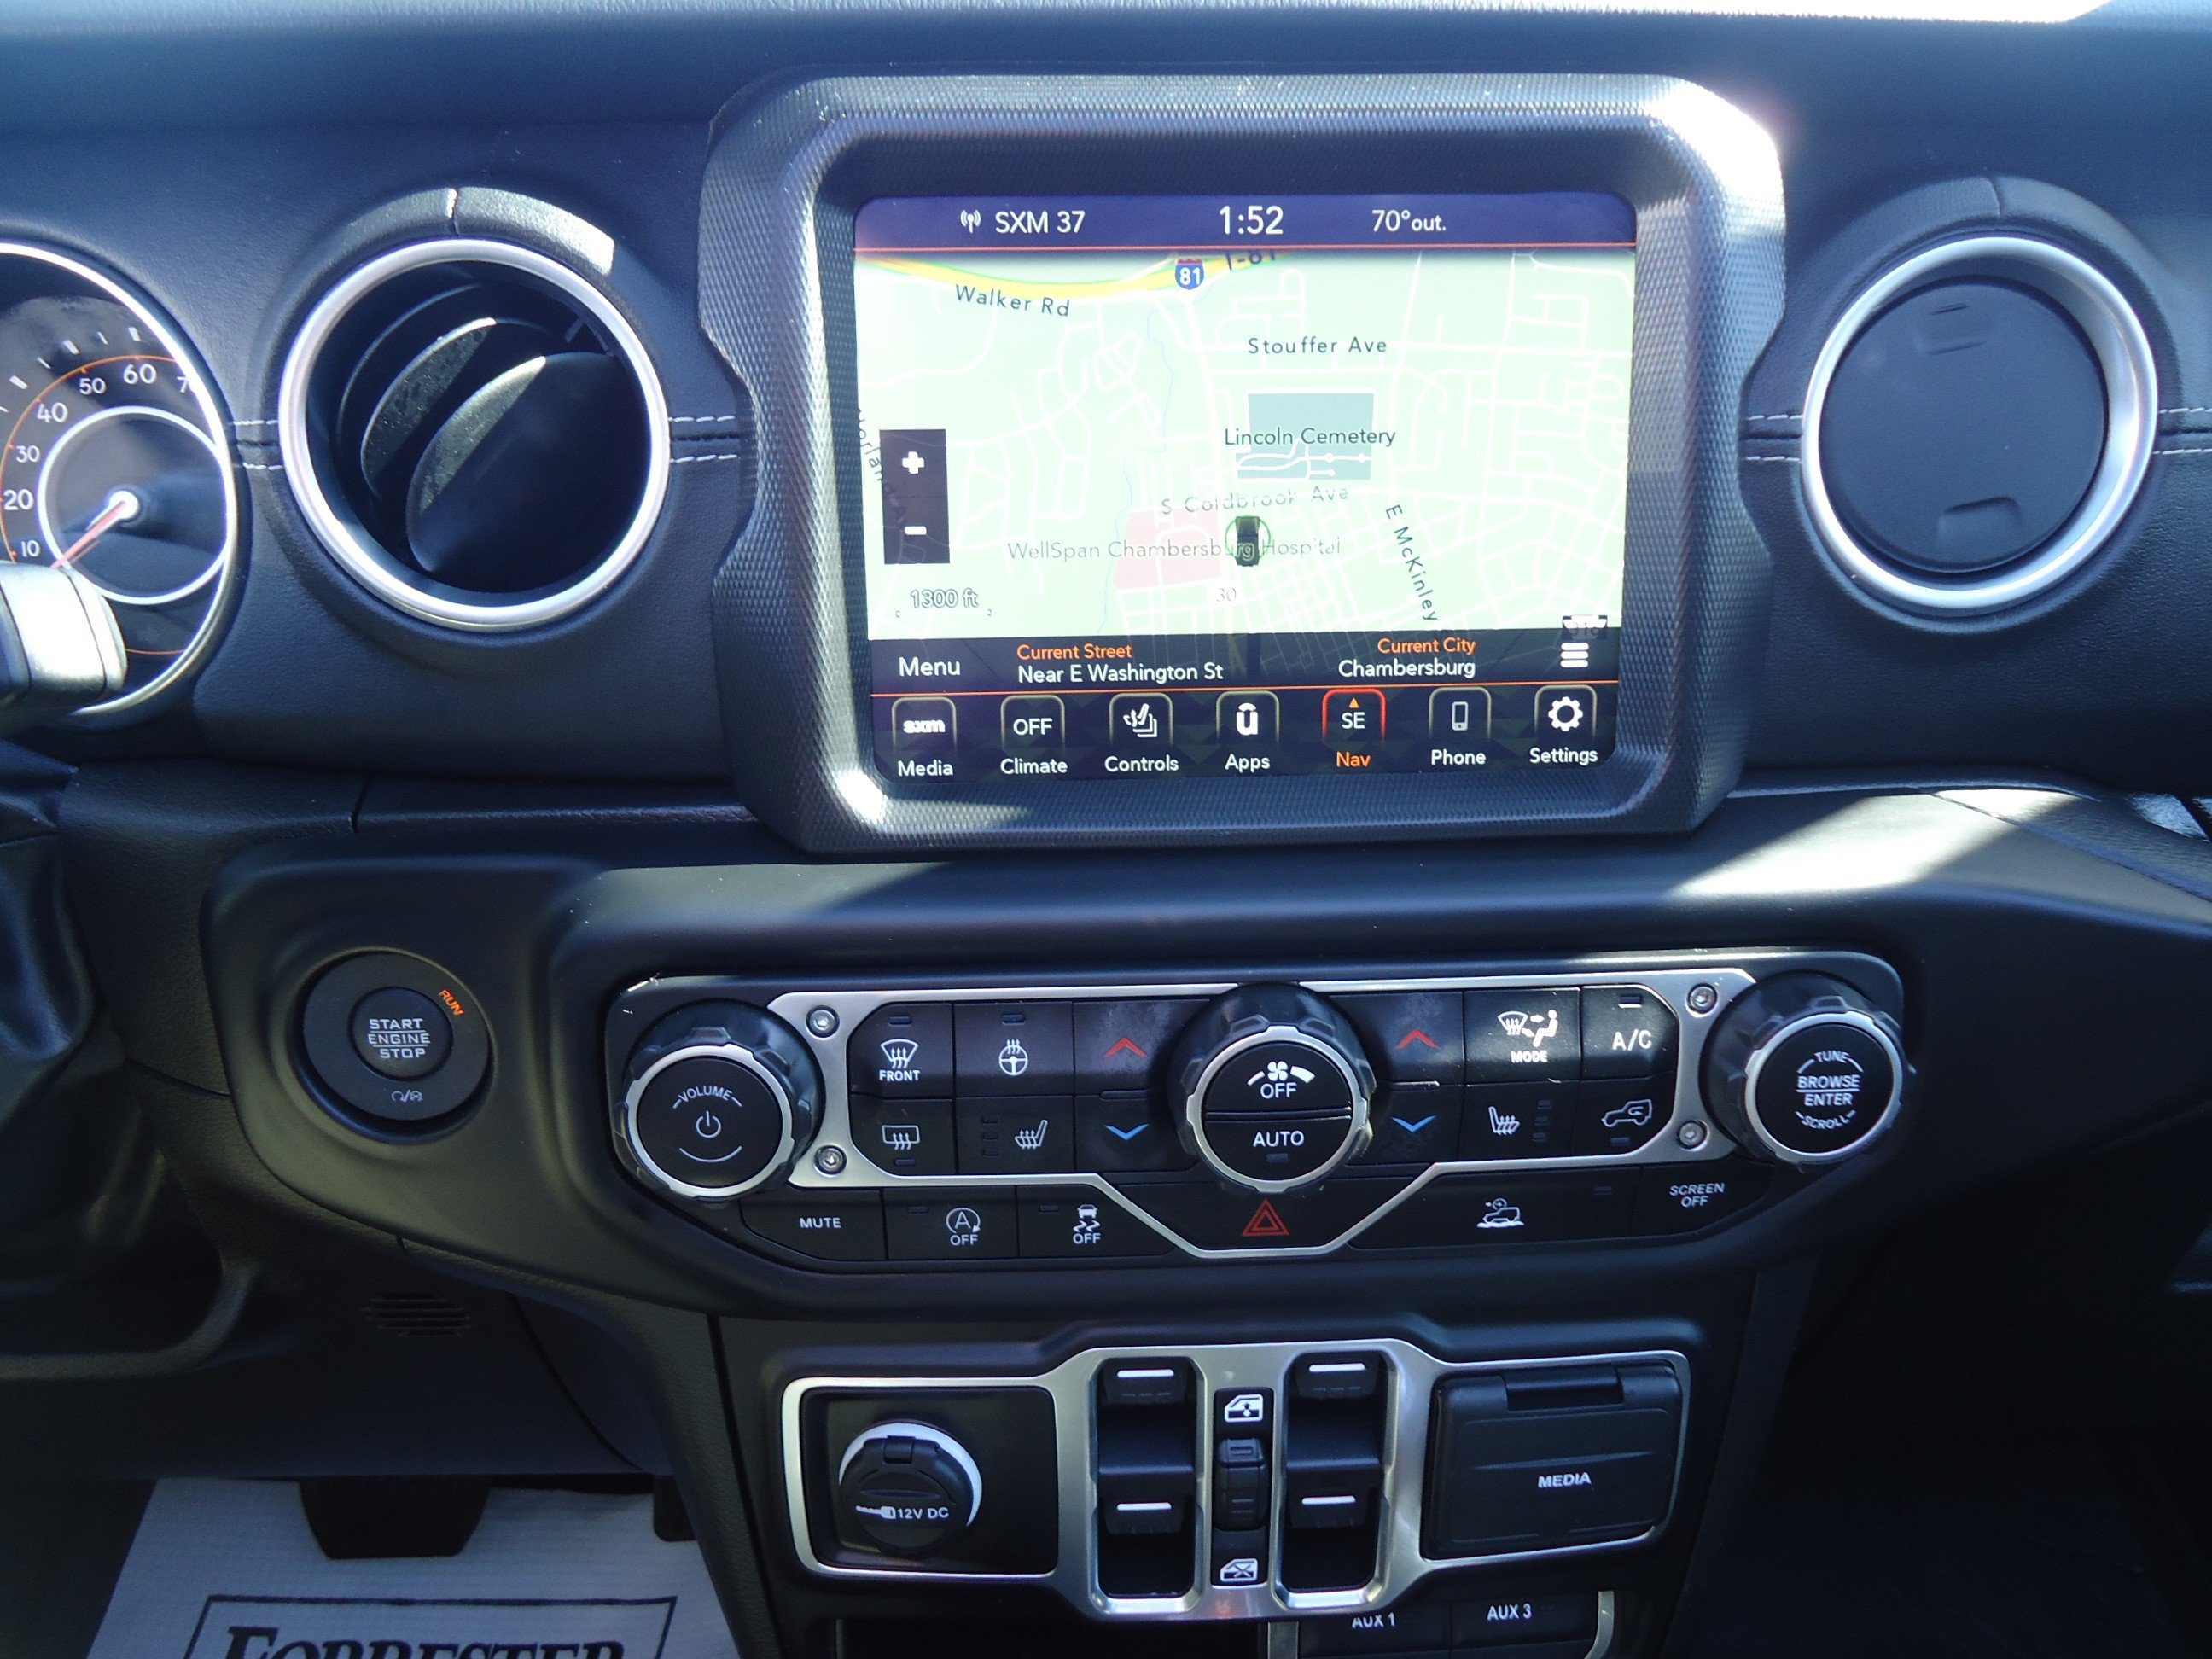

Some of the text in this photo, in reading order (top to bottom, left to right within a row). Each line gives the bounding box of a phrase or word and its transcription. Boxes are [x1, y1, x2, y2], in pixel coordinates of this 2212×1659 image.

[995, 210, 1086, 234] SXM 37
[1219, 206, 1284, 235] 1:52
[1179, 268, 1202, 286] 81
[955, 283, 1070, 317] Walker Rd
[1248, 335, 1387, 354] Stouffer Ave
[123, 363, 157, 384] 60
[79, 377, 107, 395] 50
[176, 375, 191, 393] 7
[37, 402, 68, 423] 40
[1224, 427, 1396, 447] Lincoln Cemetery
[15, 445, 41, 463] 30
[3, 488, 34, 511] 20
[1161, 498, 1173, 515] S
[1311, 486, 1348, 501] Ave
[20, 540, 41, 558] 10
[1007, 540, 1100, 562] WellSpan
[1385, 504, 1438, 622] E McKinley
[910, 587, 979, 608] 1300 ft
[1016, 643, 1132, 660] Current Street
[1377, 637, 1476, 655] Current City
[899, 656, 961, 678] Menu
[1018, 661, 1224, 685] Near E Washington St
[1338, 658, 1476, 679] Chambersburg
[1013, 718, 1053, 736] OFF
[1341, 712, 1366, 730] SE
[1104, 754, 1179, 772] Controls
[1225, 753, 1271, 773] Apps
[1336, 752, 1371, 767] Nav
[1431, 749, 1487, 765] Phone
[1529, 747, 1598, 766] Settings
[897, 760, 954, 777] Media
[1000, 758, 1068, 775] Climate
[439, 989, 465, 1016] RUN
[368, 1017, 423, 1030] START
[367, 1033, 431, 1045] ENGINE
[1612, 1029, 1652, 1051] A/C
[380, 1047, 426, 1059] STOP
[1511, 1051, 1548, 1063] MODE
[1814, 1050, 1850, 1063] TUNE
[878, 1069, 921, 1081] FRONT
[1796, 1074, 1861, 1089] BROWSE
[678, 1086, 732, 1103] VOLUME
[1260, 1082, 1297, 1099] OFF
[1803, 1092, 1853, 1107] ENTER
[1801, 1114, 1849, 1130] SCROLL
[1252, 1130, 1305, 1148] AUTO
[1669, 1183, 1726, 1196] SCREEN
[1680, 1196, 1709, 1208] OFF
[799, 1217, 841, 1229] MUTE
[950, 1234, 979, 1246] OFF
[1072, 1233, 1102, 1245] OFF
[1538, 1471, 1592, 1489] MEDIA
[897, 1506, 949, 1520] 12V DC
[1352, 1613, 1395, 1629] AUX 1
[1487, 1603, 1532, 1621] AUX 3
